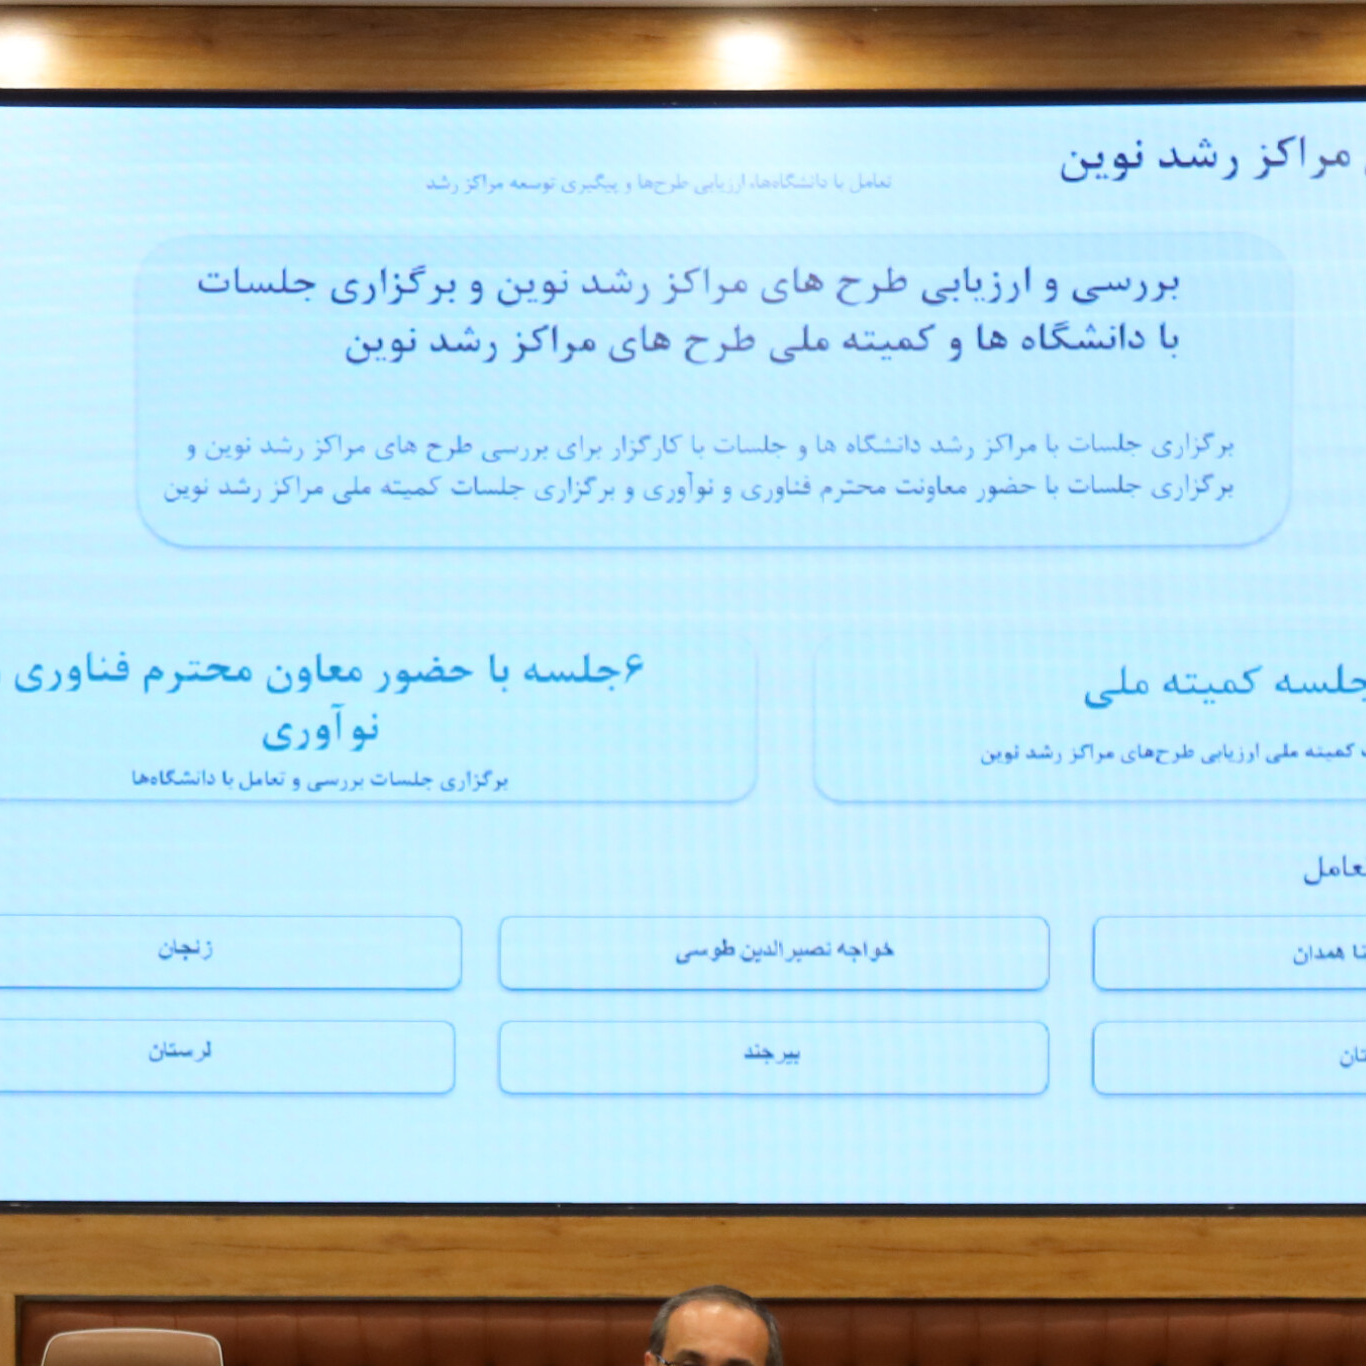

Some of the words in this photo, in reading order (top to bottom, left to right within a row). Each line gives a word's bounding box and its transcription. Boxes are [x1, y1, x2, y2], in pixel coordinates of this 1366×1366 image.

[1059, 138, 1145, 184] نوین
[1157, 137, 1240, 182] رشد
[1252, 134, 1352, 181] مراکز
[197, 265, 318, 303] جلسات
[329, 263, 458, 307] برگزاری
[469, 278, 485, 307] و
[496, 269, 570, 309] نوین
[580, 267, 651, 306] رشد
[661, 266, 748, 306] مراکز
[760, 266, 825, 306] های
[835, 266, 908, 308] طرح
[920, 264, 1032, 308] ارزیابی
[1043, 277, 1059, 304] و
[1071, 275, 1181, 307] بررسی
[344, 327, 418, 367] نوین
[428, 325, 499, 365] رشد
[510, 323, 597, 365] مراکز
[608, 324, 672, 364] های
[683, 324, 756, 366] طرح
[768, 323, 831, 366] ملی
[841, 322, 937, 362] کمیته
[948, 336, 963, 364] و
[976, 322, 1009, 352] ها
[1020, 319, 1147, 352] دانشگاه
[1158, 321, 1180, 360] با
[186, 443, 198, 462] و
[204, 436, 253, 462] نوین
[259, 436, 305, 463] رشد
[311, 432, 366, 463] مراکز
[373, 433, 418, 462] های
[424, 433, 474, 464] طرح
[479, 444, 550, 464] بررسی
[555, 434, 603, 463] برای
[609, 433, 684, 463] کارگزار
[690, 433, 706, 460] با
[712, 433, 788, 460] جلسات
[796, 444, 808, 463] و
[815, 433, 838, 455] ها
[845, 432, 922, 455] دانشگاه
[929, 435, 976, 462] رشد
[983, 432, 1038, 462] مراکز
[1045, 432, 1060, 459] با
[1067, 431, 1143, 454] جلسات
[1150, 430, 1235, 461] برگزاری
[163, 478, 209, 504] نوین
[218, 477, 262, 505] رشد
[268, 474, 325, 505] مراکز
[331, 474, 372, 506] ملی
[379, 474, 443, 501] کمیته
[449, 474, 527, 497] جلسات
[533, 474, 616, 505] برگزاری
[623, 485, 636, 505] و
[642, 470, 715, 505] نوآوری
[721, 485, 733, 504] و
[739, 475, 812, 505] فناوری
[819, 479, 887, 505] محترم
[894, 474, 968, 504] معاونت
[974, 476, 1037, 504] حضور
[1045, 474, 1060, 496] با
[1067, 473, 1143, 495] جلسات
[1150, 472, 1235, 503] برگزاری
[14, 650, 130, 694] فناوری
[143, 660, 253, 695] محترم
[265, 652, 364, 695] معاون
[374, 656, 474, 695] حضور
[488, 653, 510, 693] با
[1162, 664, 1264, 705] کمیته
[1083, 665, 1150, 711] ملی
[979, 743, 1021, 767] نوین
[1025, 744, 1063, 766] رشد
[1069, 742, 1116, 765] مراکز
[1200, 742, 1260, 766] ارزیابی
[1264, 741, 1300, 766] ملی
[1304, 741, 1357, 762] کمیته
[221, 769, 235, 787] با
[238, 770, 286, 793] تعامل
[291, 776, 302, 793] و
[306, 777, 365, 794] بررسی
[369, 770, 434, 791] جلسات
[439, 768, 510, 793] برگزاری
[157, 938, 214, 962] زنجان
[675, 937, 736, 967] طوسی
[836, 941, 896, 964] خواجه
[1292, 944, 1346, 967] همدان
[147, 1039, 213, 1064] لرستان
[743, 1043, 801, 1066] بیرجند
